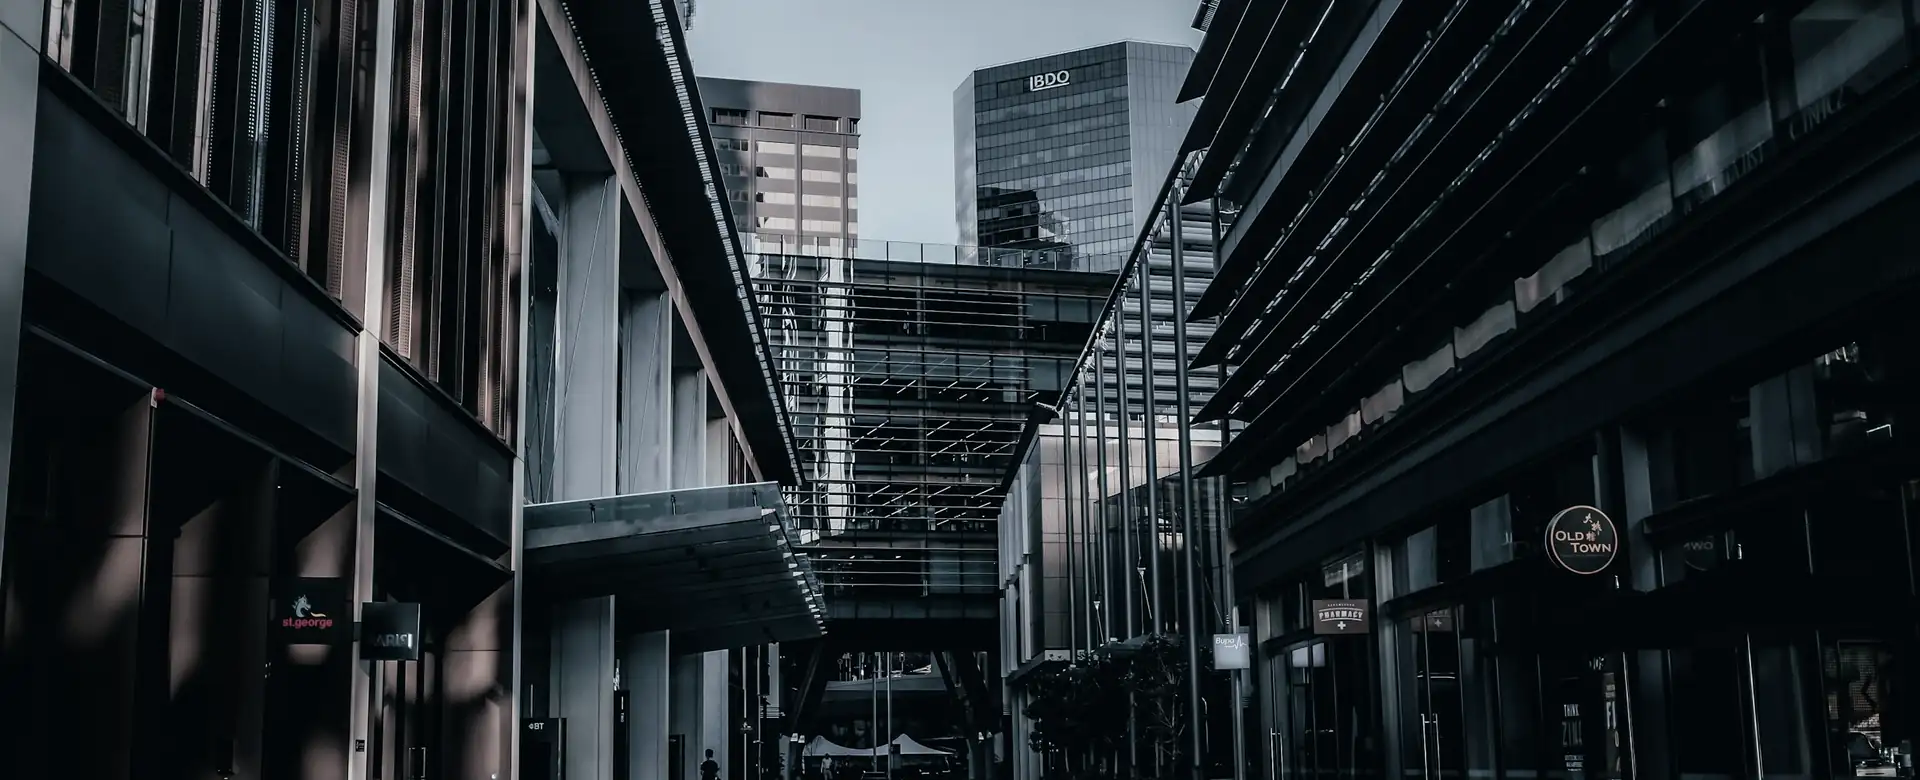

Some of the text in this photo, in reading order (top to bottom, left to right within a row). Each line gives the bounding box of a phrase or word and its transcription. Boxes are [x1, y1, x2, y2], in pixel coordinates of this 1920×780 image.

[1033, 70, 1070, 88] BDO
[1555, 530, 1584, 541] OLD
[1570, 542, 1612, 553] TOWN
[1318, 610, 1363, 620] PHARMACY
[282, 616, 333, 629] st.george
[1215, 637, 1235, 646] Bupa
